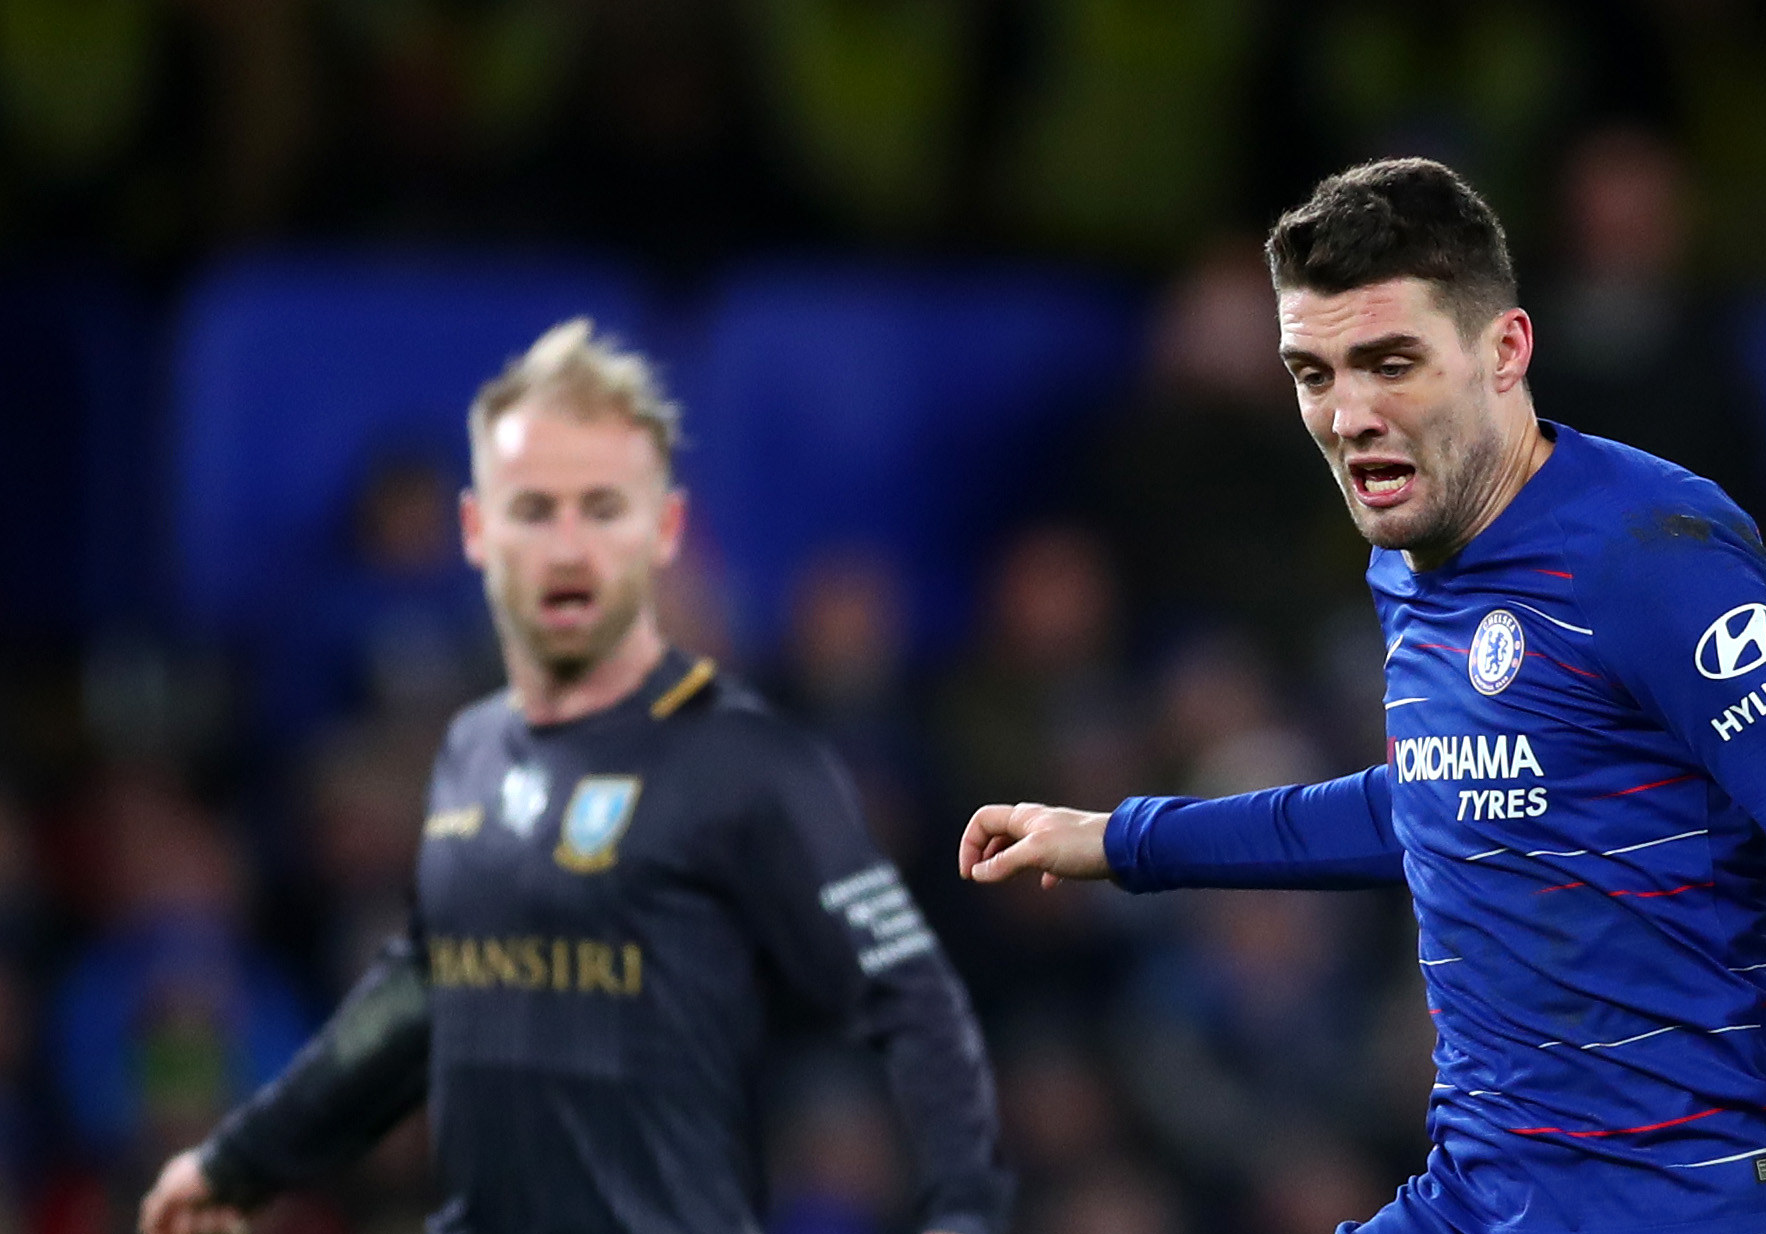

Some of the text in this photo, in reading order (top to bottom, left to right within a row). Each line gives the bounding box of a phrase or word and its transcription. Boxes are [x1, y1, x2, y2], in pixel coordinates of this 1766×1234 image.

[1482, 614, 1516, 633] CHELSEA
[1394, 734, 1545, 784] YOKOHAMA
[1457, 787, 1548, 822] TYRES
